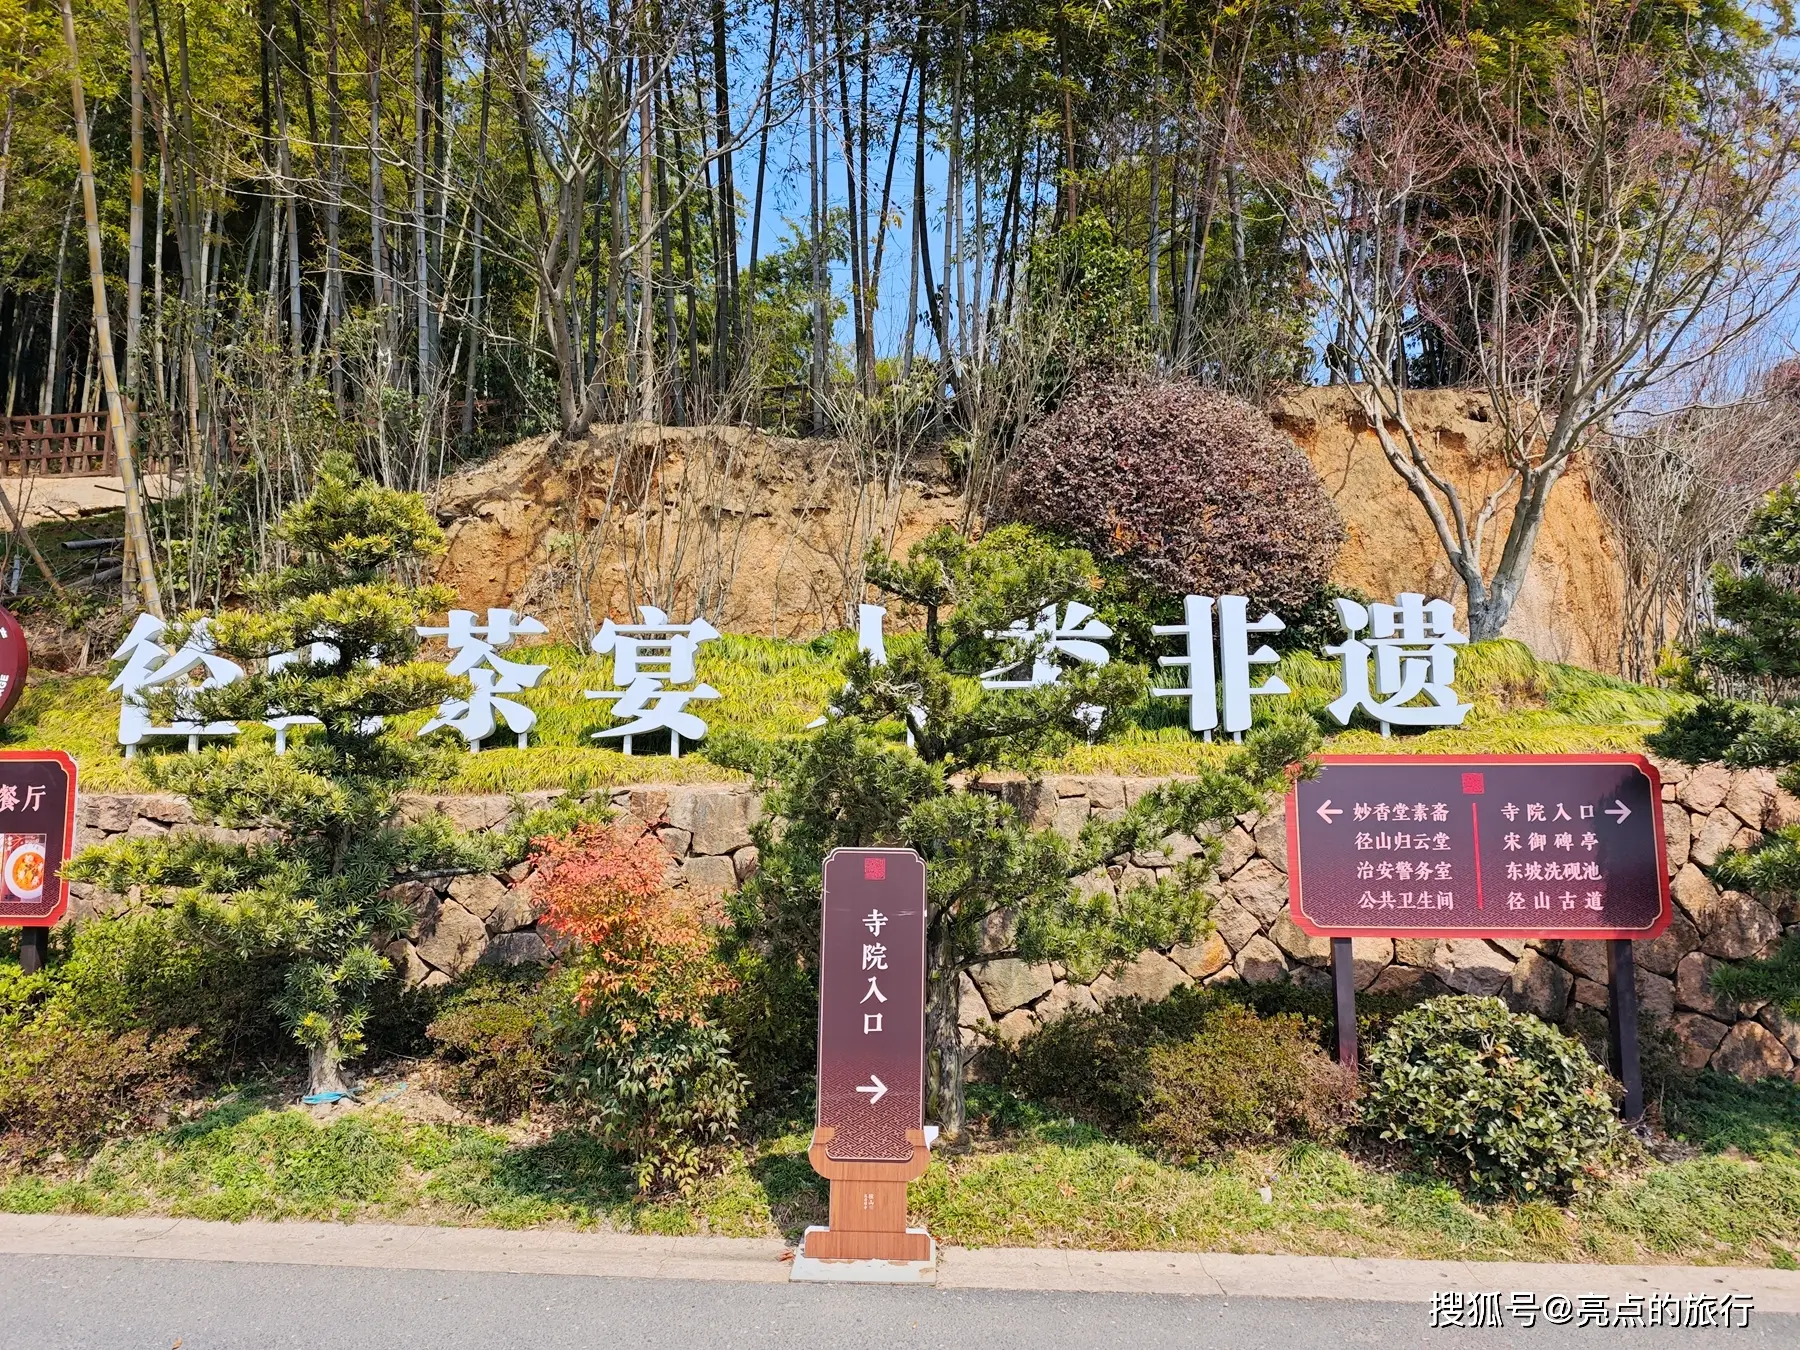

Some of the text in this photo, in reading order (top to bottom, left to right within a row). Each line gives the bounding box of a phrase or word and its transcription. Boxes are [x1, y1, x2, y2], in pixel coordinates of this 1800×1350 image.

[1352, 802, 1450, 823] 妙香堂素斋
[1500, 802, 1596, 823] 寺院入口
[1354, 831, 1452, 852] 径山归云堂
[1502, 831, 1600, 852] 宋御碑亭
[1356, 861, 1453, 881] 治安警务室
[1505, 861, 1603, 881] 东坡洗砚池
[1357, 890, 1454, 911] 公共卫生间
[1506, 890, 1605, 912] 径山古道
[860, 907, 889, 1036] 寺院入口
